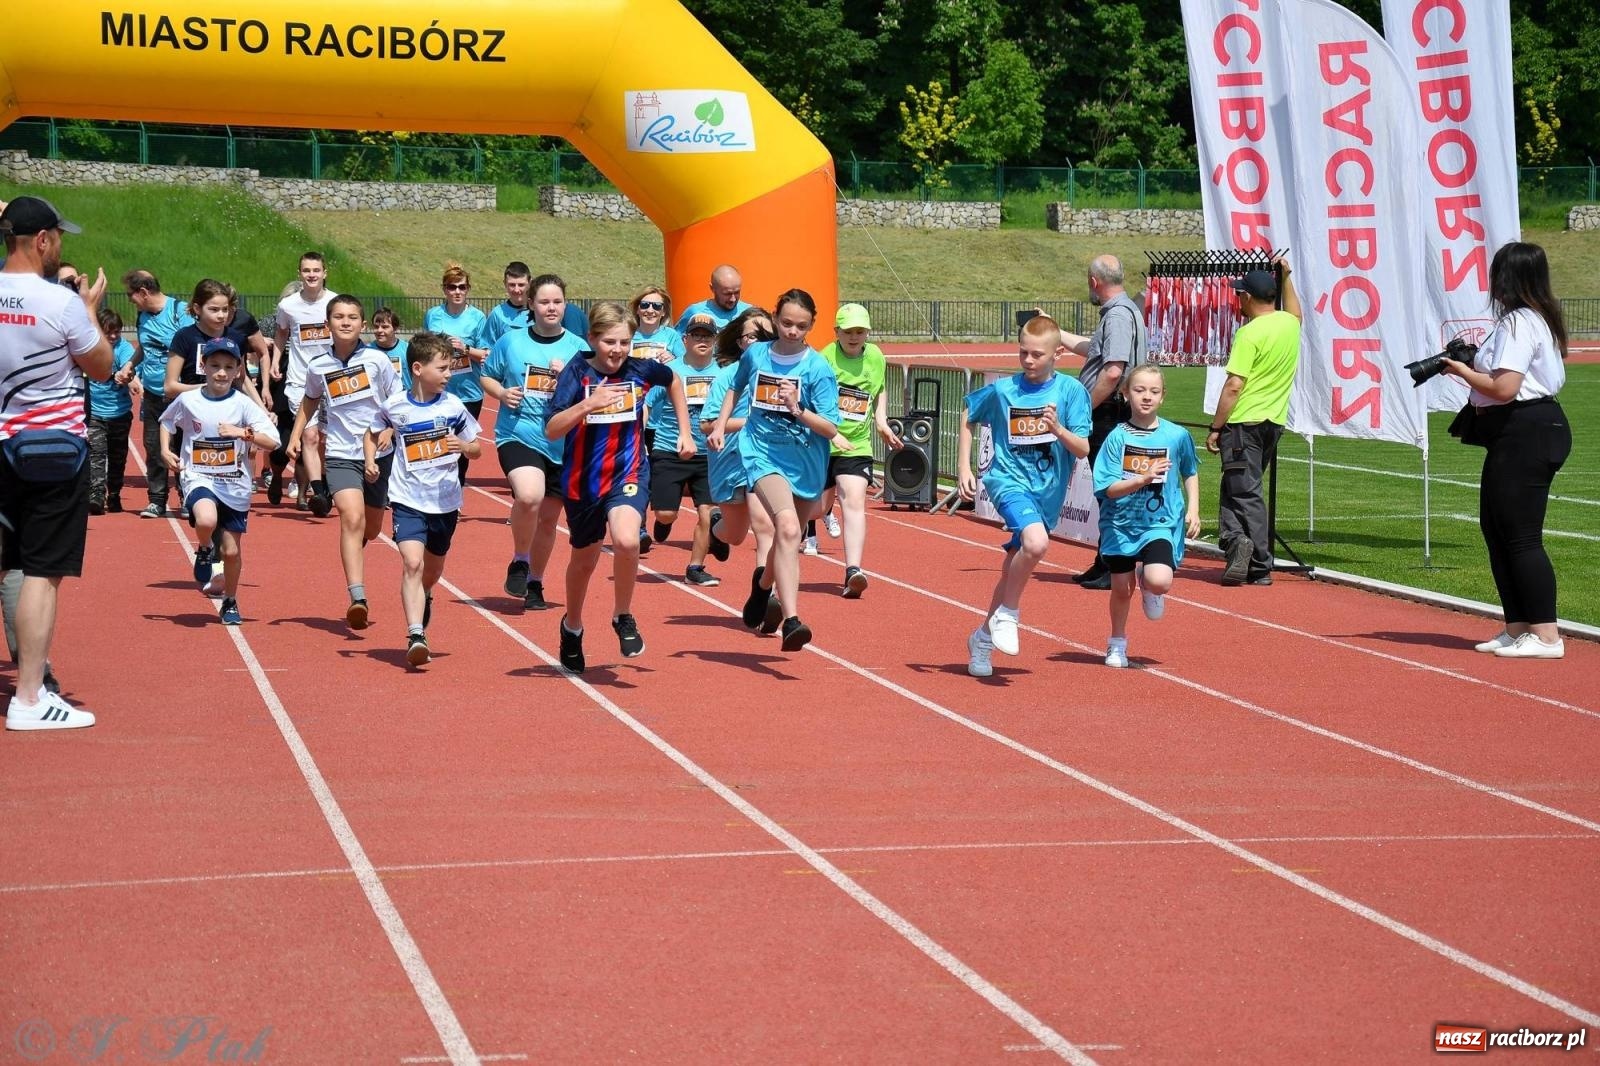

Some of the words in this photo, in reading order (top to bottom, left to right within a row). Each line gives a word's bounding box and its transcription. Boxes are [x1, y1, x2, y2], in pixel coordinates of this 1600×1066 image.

[100, 11, 270, 54] MIASTO
[284, 19, 507, 63] RACIBÓRZ
[639, 115, 747, 152] Racibórz
[305, 330, 325, 339] 064
[336, 376, 360, 393] 110
[840, 398, 863, 412] 092
[1016, 419, 1047, 433] 056
[200, 450, 228, 463] 090
[416, 439, 442, 459] 114
[1059, 501, 1091, 524] piekunów
